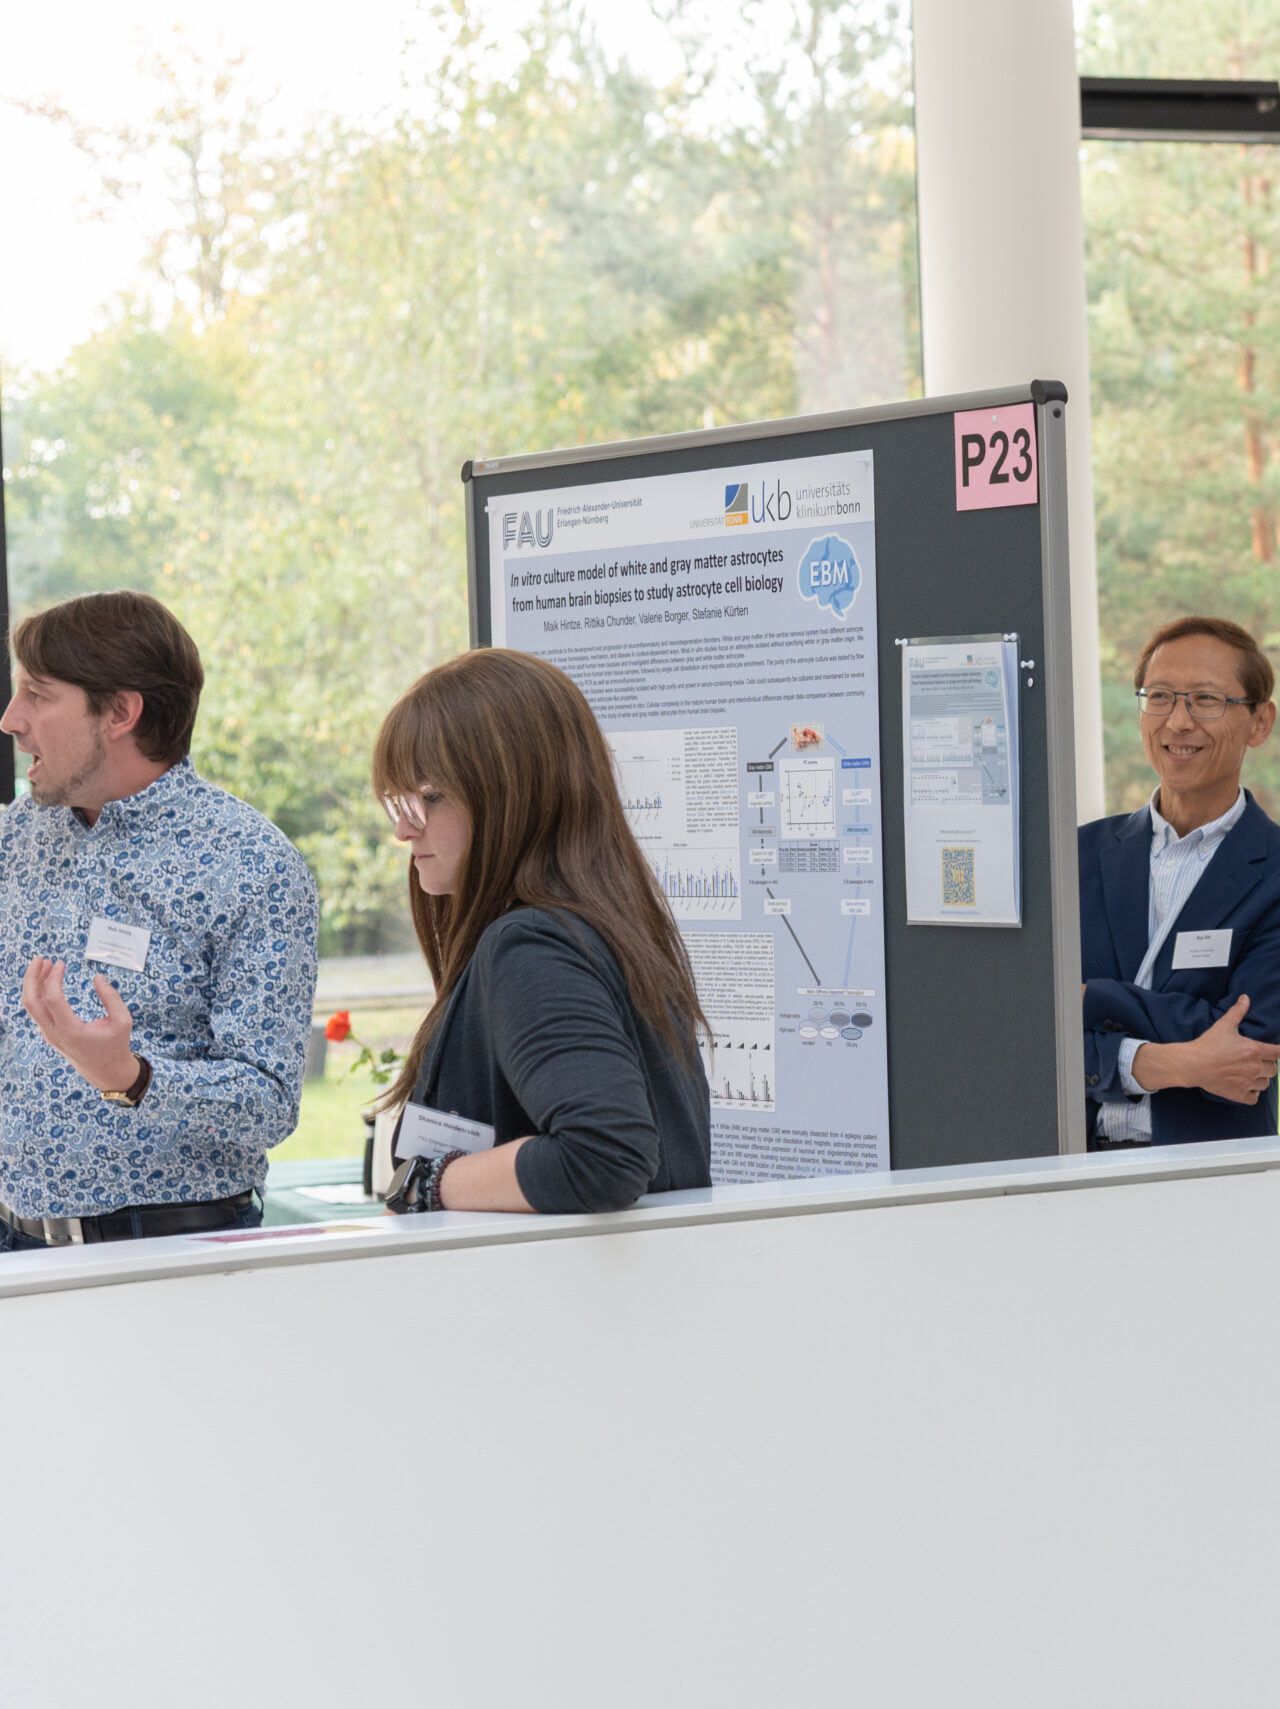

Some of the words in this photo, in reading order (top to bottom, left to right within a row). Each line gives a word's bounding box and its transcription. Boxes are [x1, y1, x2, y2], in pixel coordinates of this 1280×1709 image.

[962, 428, 1033, 488] P23
[752, 479, 792, 524] ukb
[796, 482, 851, 501] universitäts
[502, 508, 554, 551] FAU
[557, 498, 642, 516] Friedrich-Alexander-Universität
[557, 514, 609, 529] Erlangen-Nürnberg
[796, 501, 861, 519] klinikumbonn
[510, 574, 518, 588] In
[521, 572, 541, 587] vitro
[544, 568, 575, 585] culture
[577, 564, 606, 581] model
[608, 562, 618, 578] of
[620, 561, 647, 577] white
[650, 557, 668, 574] and
[670, 560, 691, 575] gray
[694, 554, 727, 571] matter
[730, 549, 784, 567] astrocytes
[810, 559, 849, 587] EBM
[512, 597, 534, 612] from
[536, 595, 566, 610] human
[568, 592, 592, 607] brain
[594, 588, 631, 607] biopsies
[634, 588, 644, 601] to
[646, 584, 673, 601] study
[676, 582, 722, 600] astrocyte
[725, 577, 742, 593] cell
[745, 574, 783, 593] biology
[543, 621, 558, 632] Maik
[560, 618, 583, 631] Hintze,
[584, 616, 604, 629] Rittika
[606, 614, 637, 627] Chunder,
[639, 611, 662, 624] Valerie
[664, 609, 690, 624] Borger,
[692, 607, 722, 620] Stefanie
[724, 605, 748, 618] Kürten
